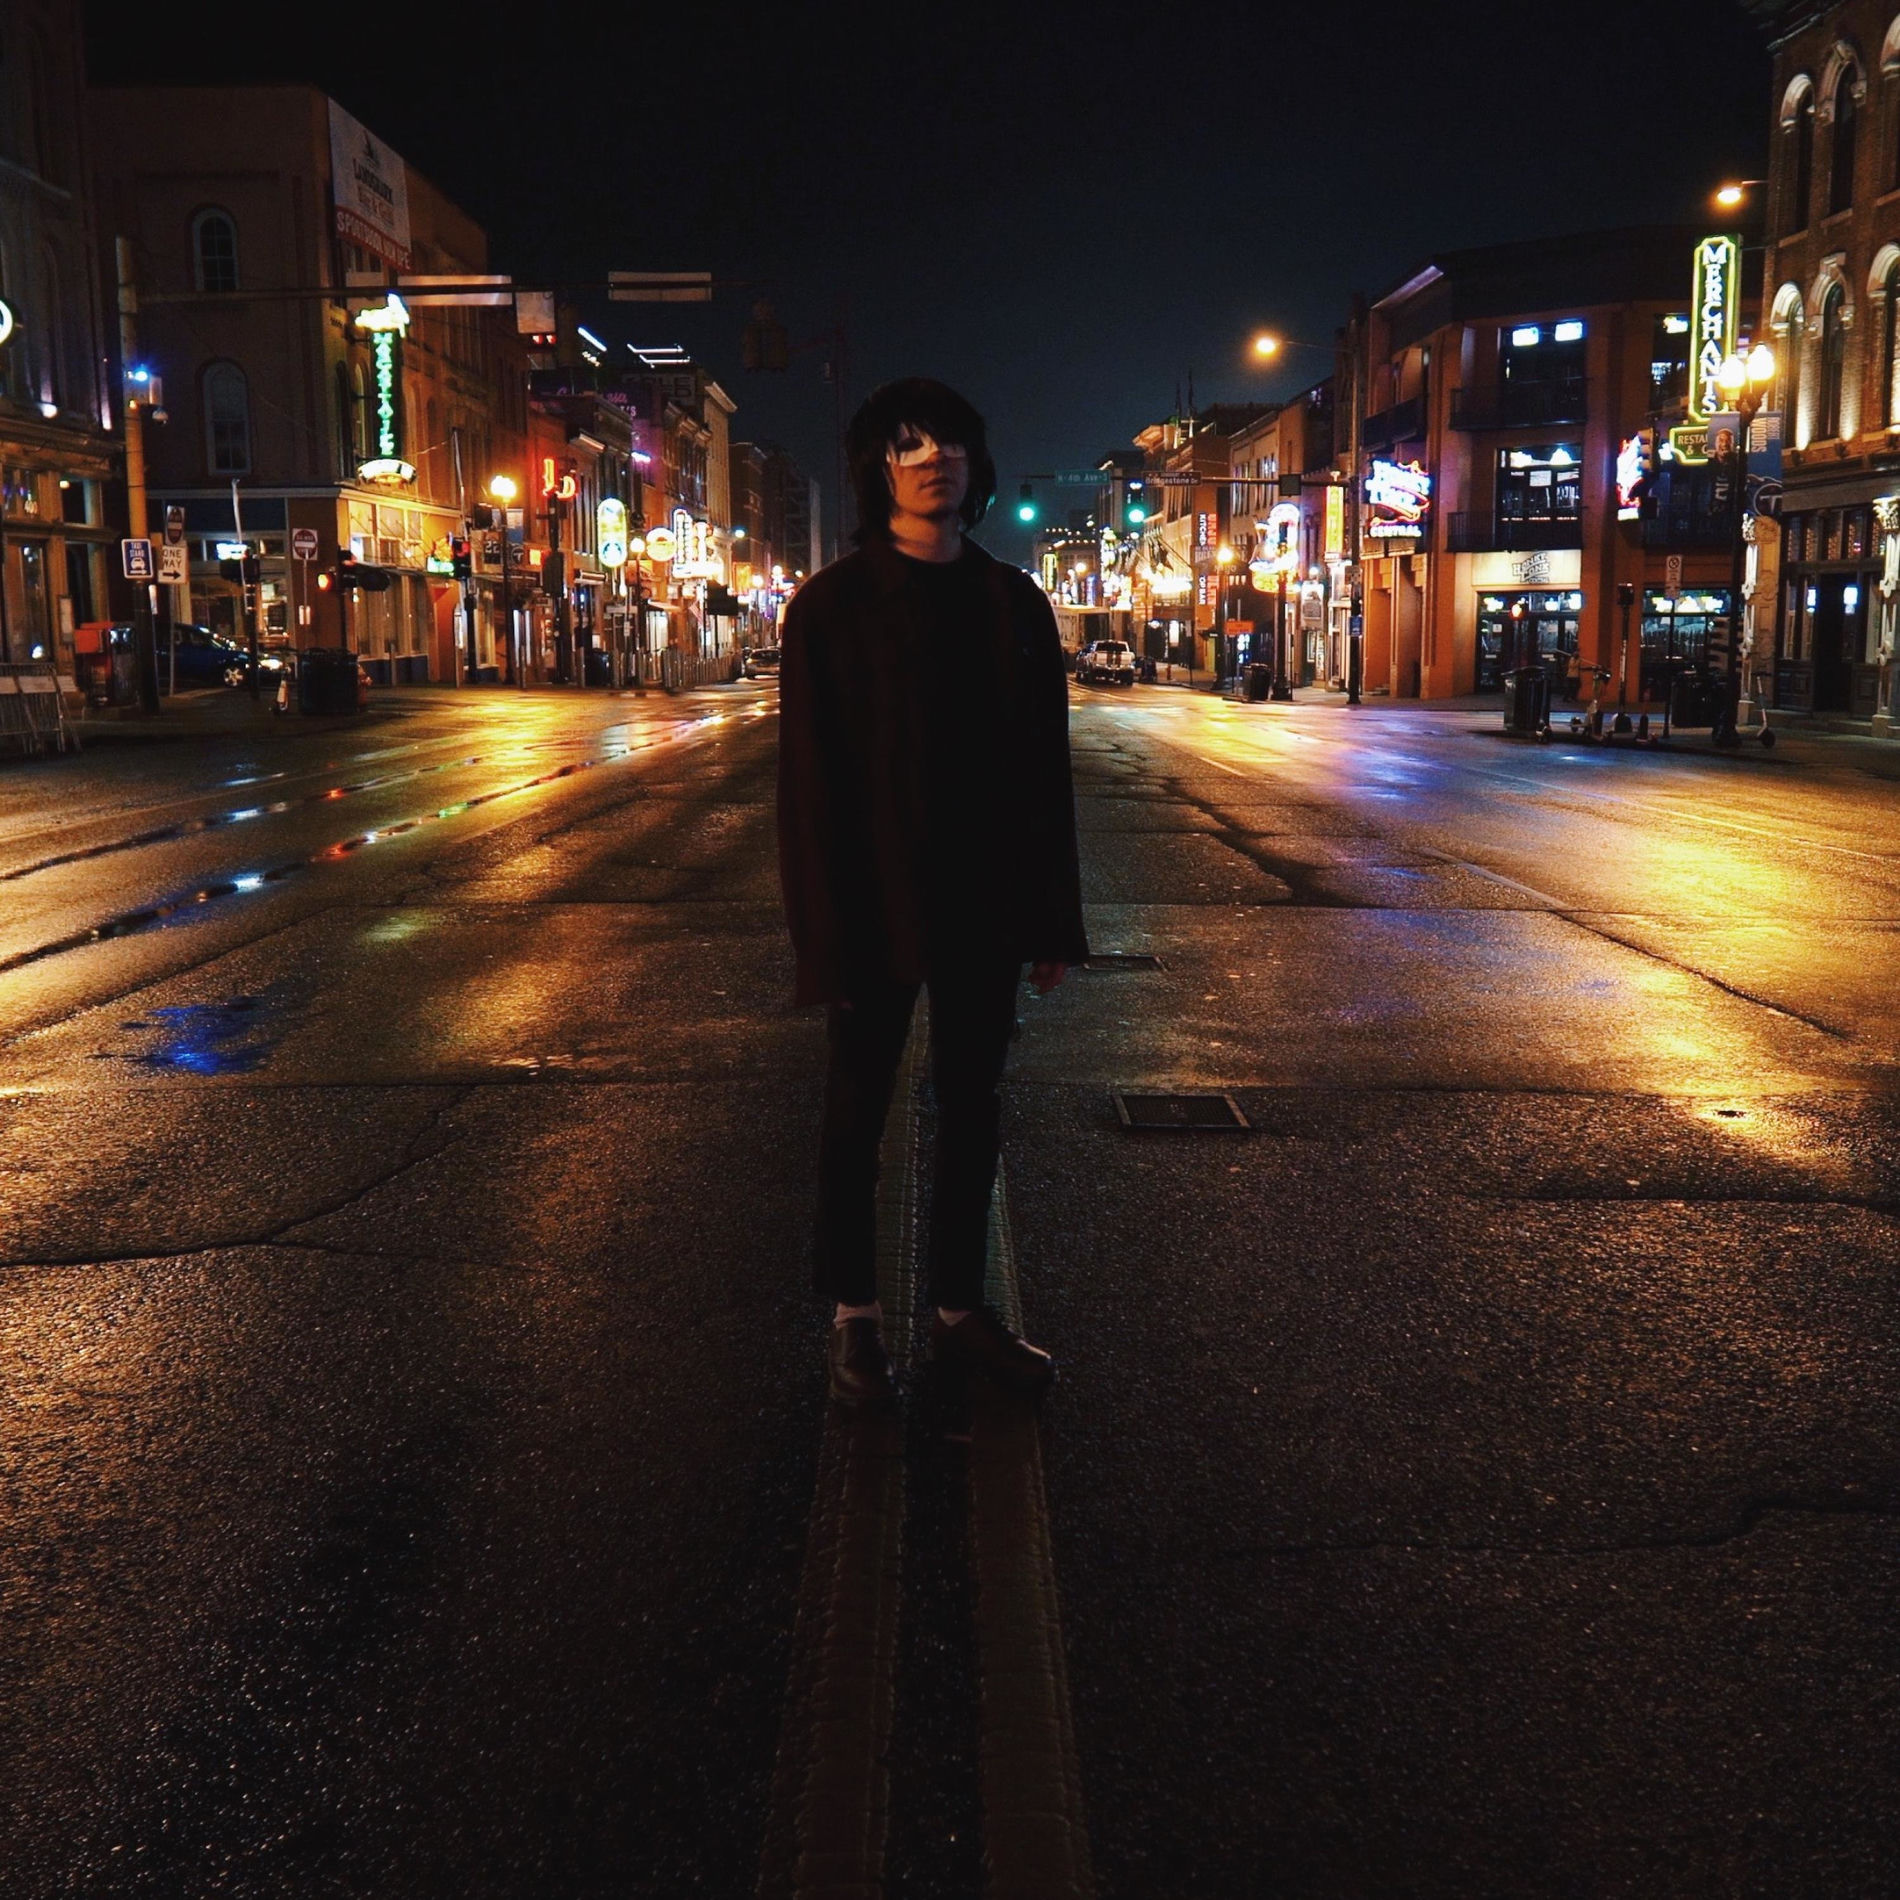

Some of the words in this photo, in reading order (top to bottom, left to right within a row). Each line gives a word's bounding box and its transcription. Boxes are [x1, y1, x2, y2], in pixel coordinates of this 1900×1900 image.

[1699, 243, 1728, 413] MERCHANTS
[1750, 417, 1767, 453] WOODS
[1686, 445, 1694, 456] &
[1145, 477, 1189, 485] Bridgestone
[1370, 525, 1422, 537] CENTRAL
[162, 549, 182, 558] ONE
